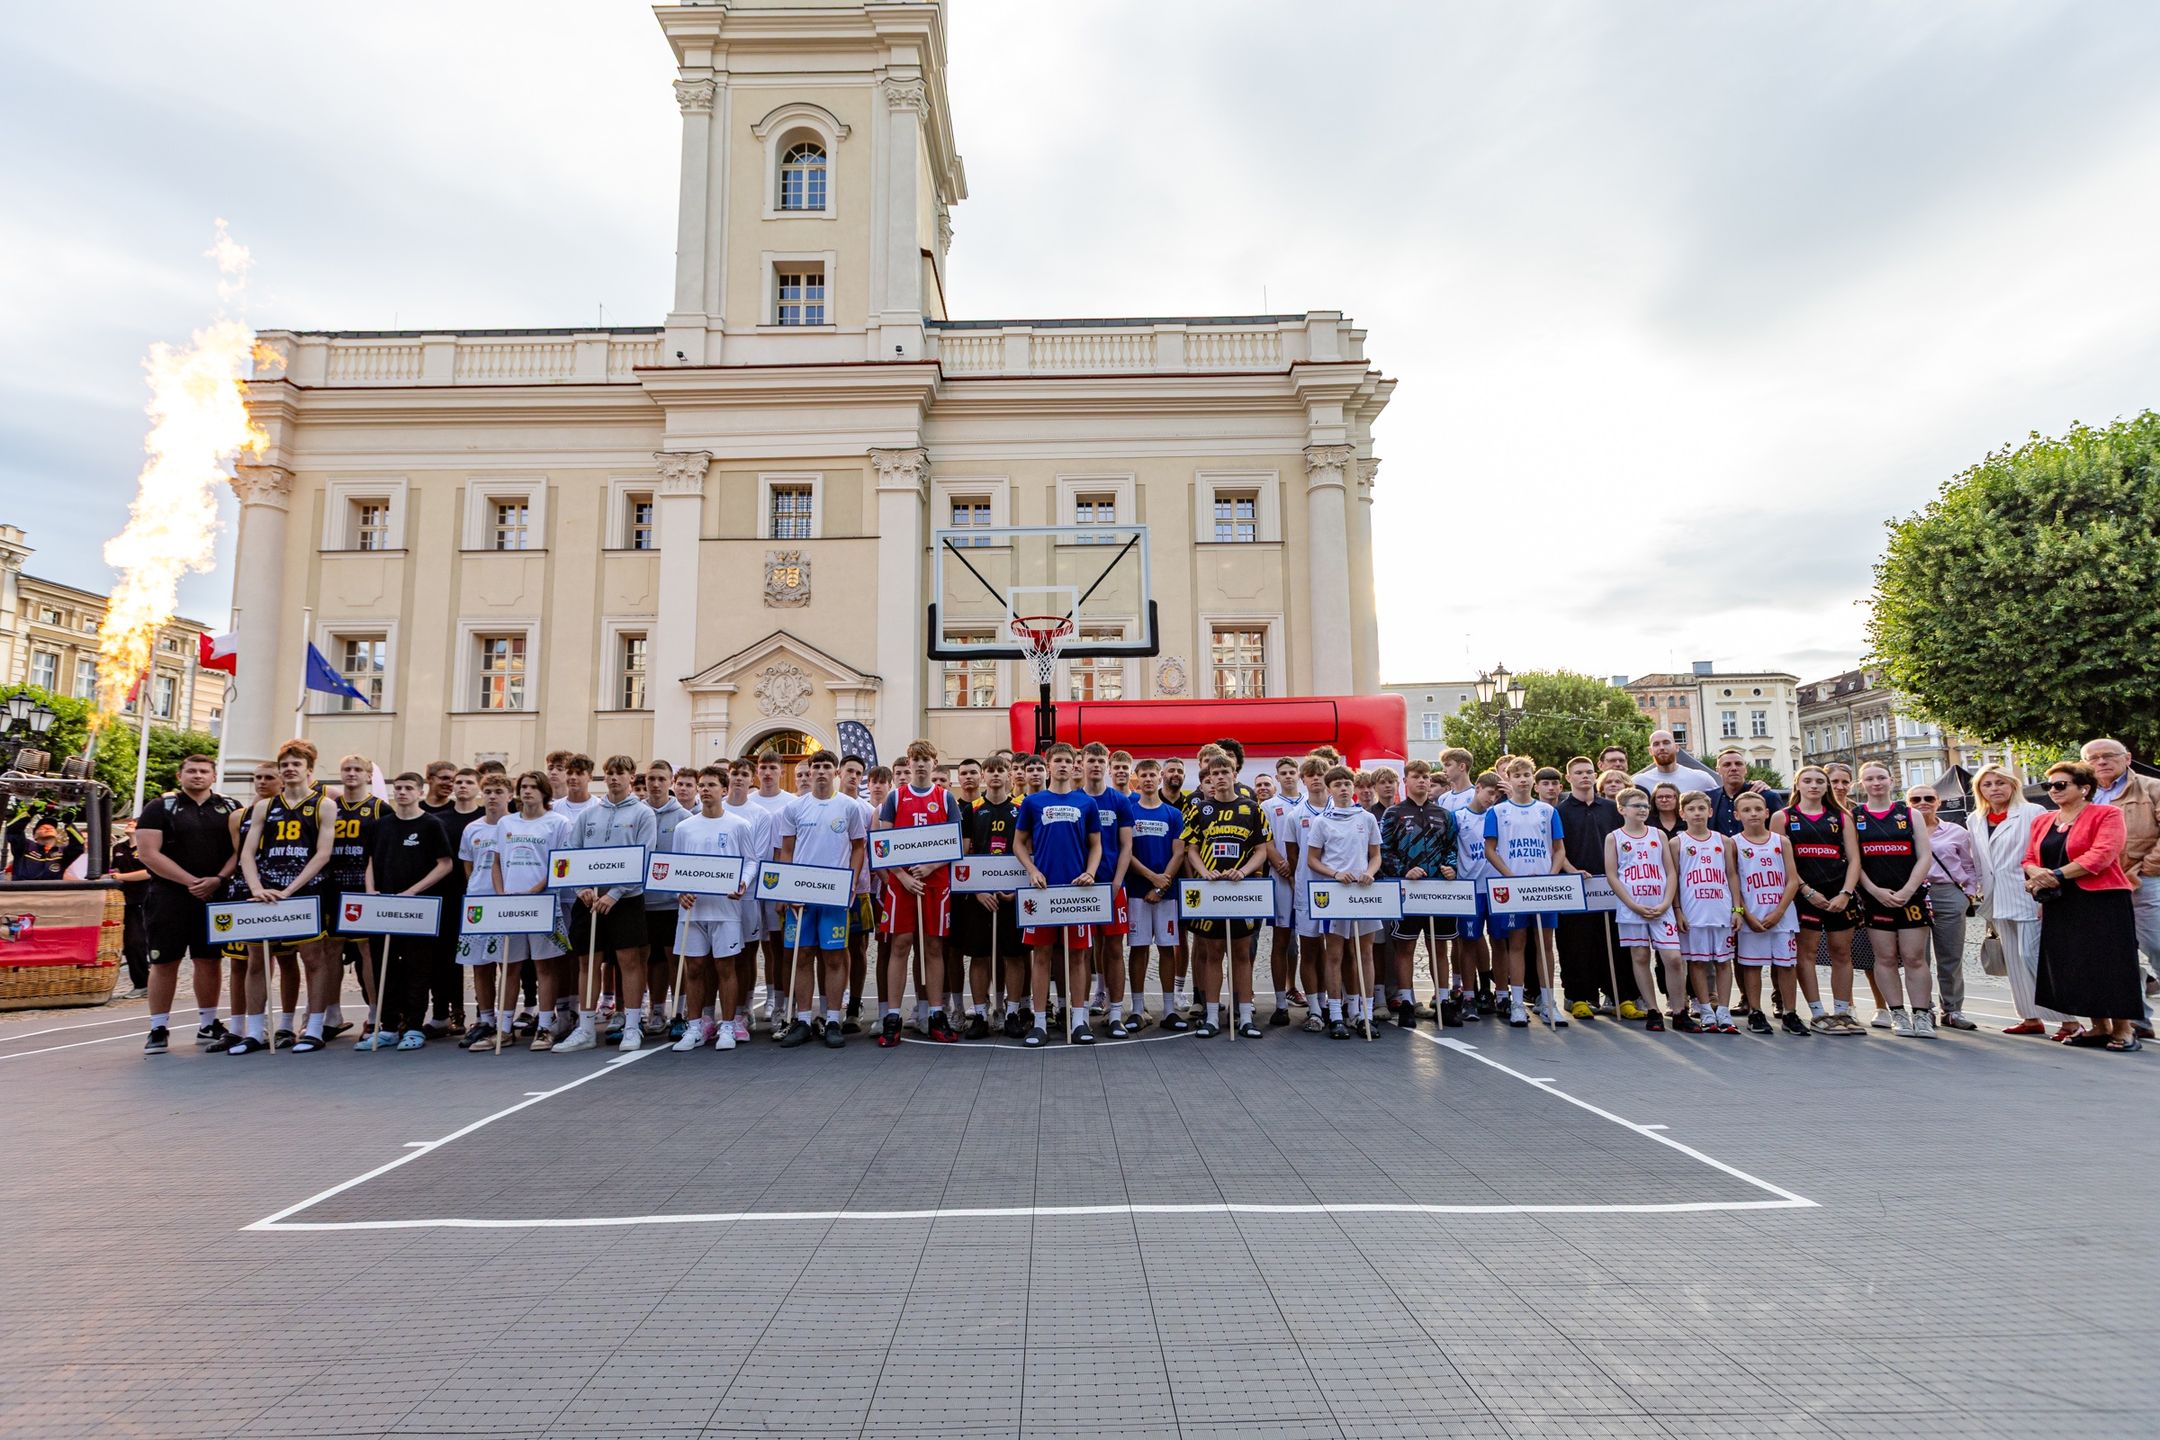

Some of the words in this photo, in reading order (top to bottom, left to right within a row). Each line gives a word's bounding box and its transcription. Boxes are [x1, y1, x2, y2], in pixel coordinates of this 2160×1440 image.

[912, 813, 927, 826] 15
[1218, 810, 1234, 821] 10
[276, 821, 301, 840] 18
[335, 820, 360, 838] 20
[991, 820, 1005, 832] 10
[1829, 823, 1839, 833] 17
[1896, 820, 1908, 830] 18
[1203, 825, 1250, 838] POMORZE
[893, 838, 957, 850] PODKARPACKIE
[1509, 838, 1545, 849] WARMIA
[1863, 844, 1904, 853] pompax
[1509, 848, 1547, 860] MAZURY
[1637, 851, 1648, 860] 34
[1797, 847, 1834, 856] pompax
[1700, 855, 1711, 864] 98
[1760, 857, 1772, 866] 99
[588, 861, 626, 871] ŁÓDZKIE
[674, 869, 735, 880] MAŁOPOLSKIE
[982, 868, 1028, 877] PODLASKIE
[794, 880, 836, 890] OPOLSKIE
[1517, 884, 1575, 895] WARMIŃSKO-
[1408, 891, 1473, 902] ŚWIĘTOKRZYSKIE
[1632, 885, 1661, 897] LESZNO
[1694, 888, 1723, 900] LESZNO
[1050, 896, 1101, 906] KUJAWSKO-
[1212, 894, 1263, 902] POMORSKIE
[1348, 895, 1383, 904] ŚLĄSKIE
[1522, 893, 1573, 902] MAZURSKIE
[498, 909, 539, 918] LUBUSKIE
[1050, 904, 1101, 914] POMORSKIE
[1904, 905, 1922, 921] 18
[237, 912, 312, 925] DOLNOŚLĄSKIE
[376, 910, 424, 920] LUBELSKIE
[1117, 908, 1127, 924] 15
[832, 926, 845, 939] 33
